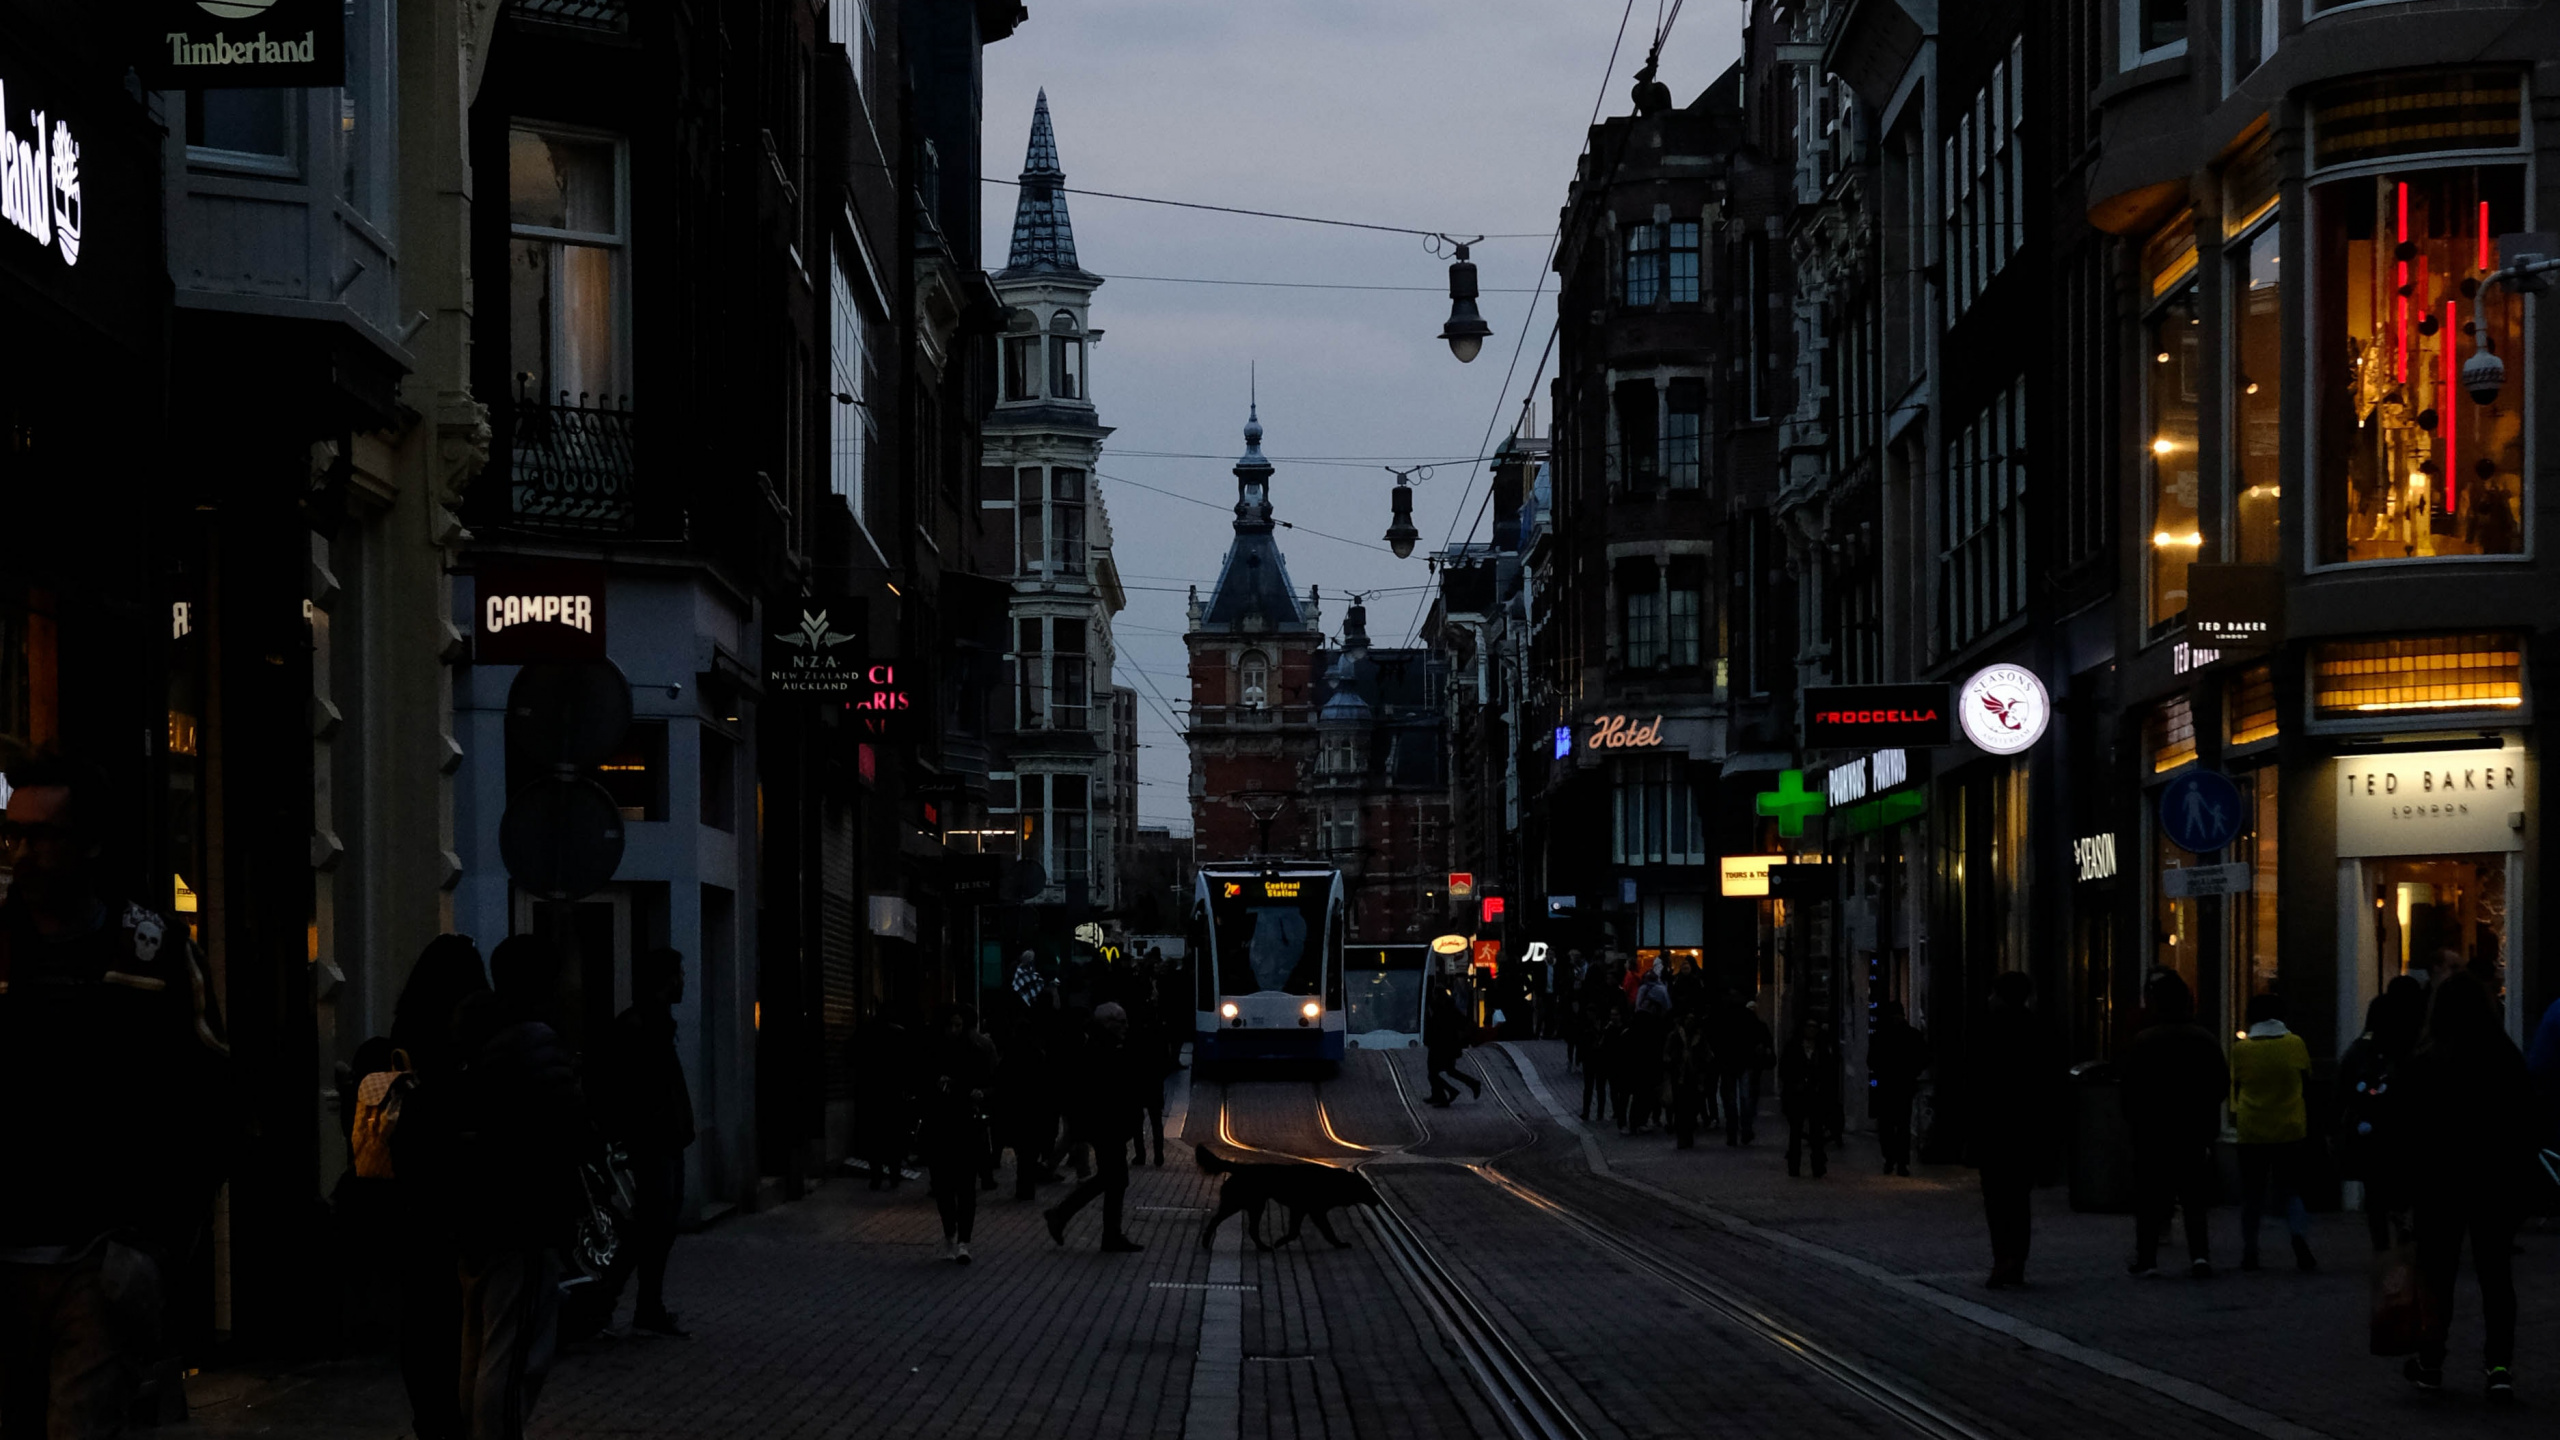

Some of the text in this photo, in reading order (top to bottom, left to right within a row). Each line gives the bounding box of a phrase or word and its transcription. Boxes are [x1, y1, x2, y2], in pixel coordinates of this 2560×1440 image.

[166, 30, 315, 66] Timberland
[486, 595, 592, 634] CAMPER
[2198, 620, 2267, 632] TED BAKER
[2173, 641, 2190, 675] TED
[771, 671, 859, 680] NEW ZEALAND
[868, 665, 894, 685] CI
[1973, 671, 2033, 694] SEASONS
[782, 682, 849, 690] AUCKLAND
[1815, 709, 1938, 724] FROCCELLA
[1588, 714, 1664, 749] Hotel
[2347, 767, 2517, 796] TED BAKER
[2391, 803, 2469, 819] LONDON
[1725, 871, 1748, 879] TOURS
[1224, 881, 1301, 898] 2 Centraal
[1267, 889, 1298, 898] Station
[1379, 951, 1386, 964] 1
[1521, 941, 1550, 962] JD
